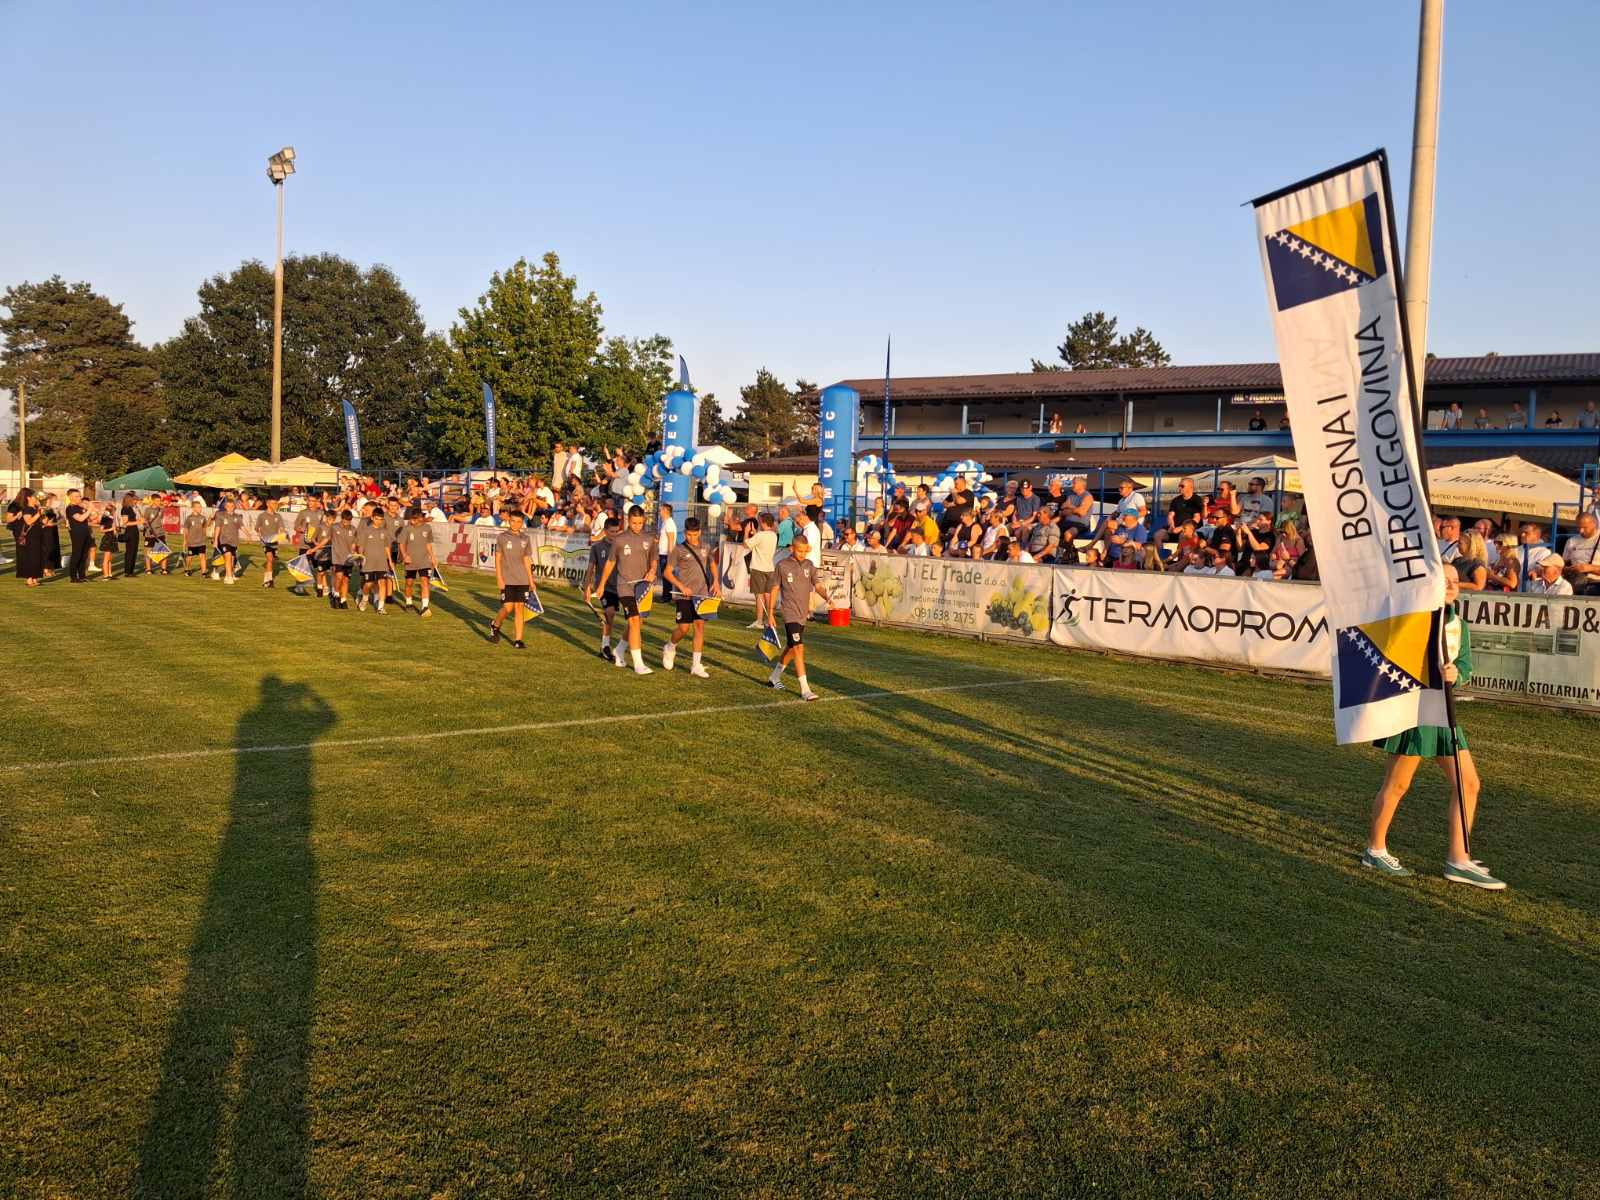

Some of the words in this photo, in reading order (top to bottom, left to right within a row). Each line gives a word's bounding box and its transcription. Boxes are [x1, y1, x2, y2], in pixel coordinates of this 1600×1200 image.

[1316, 393, 1348, 405] I
[1354, 315, 1427, 584] HERCEGOVINA
[822, 410, 836, 513] IMUREC
[1321, 409, 1373, 541] BOSNA
[530, 563, 556, 578] PTIKA
[942, 564, 982, 585] Trade
[1468, 675, 1525, 693] NUTARNJA
